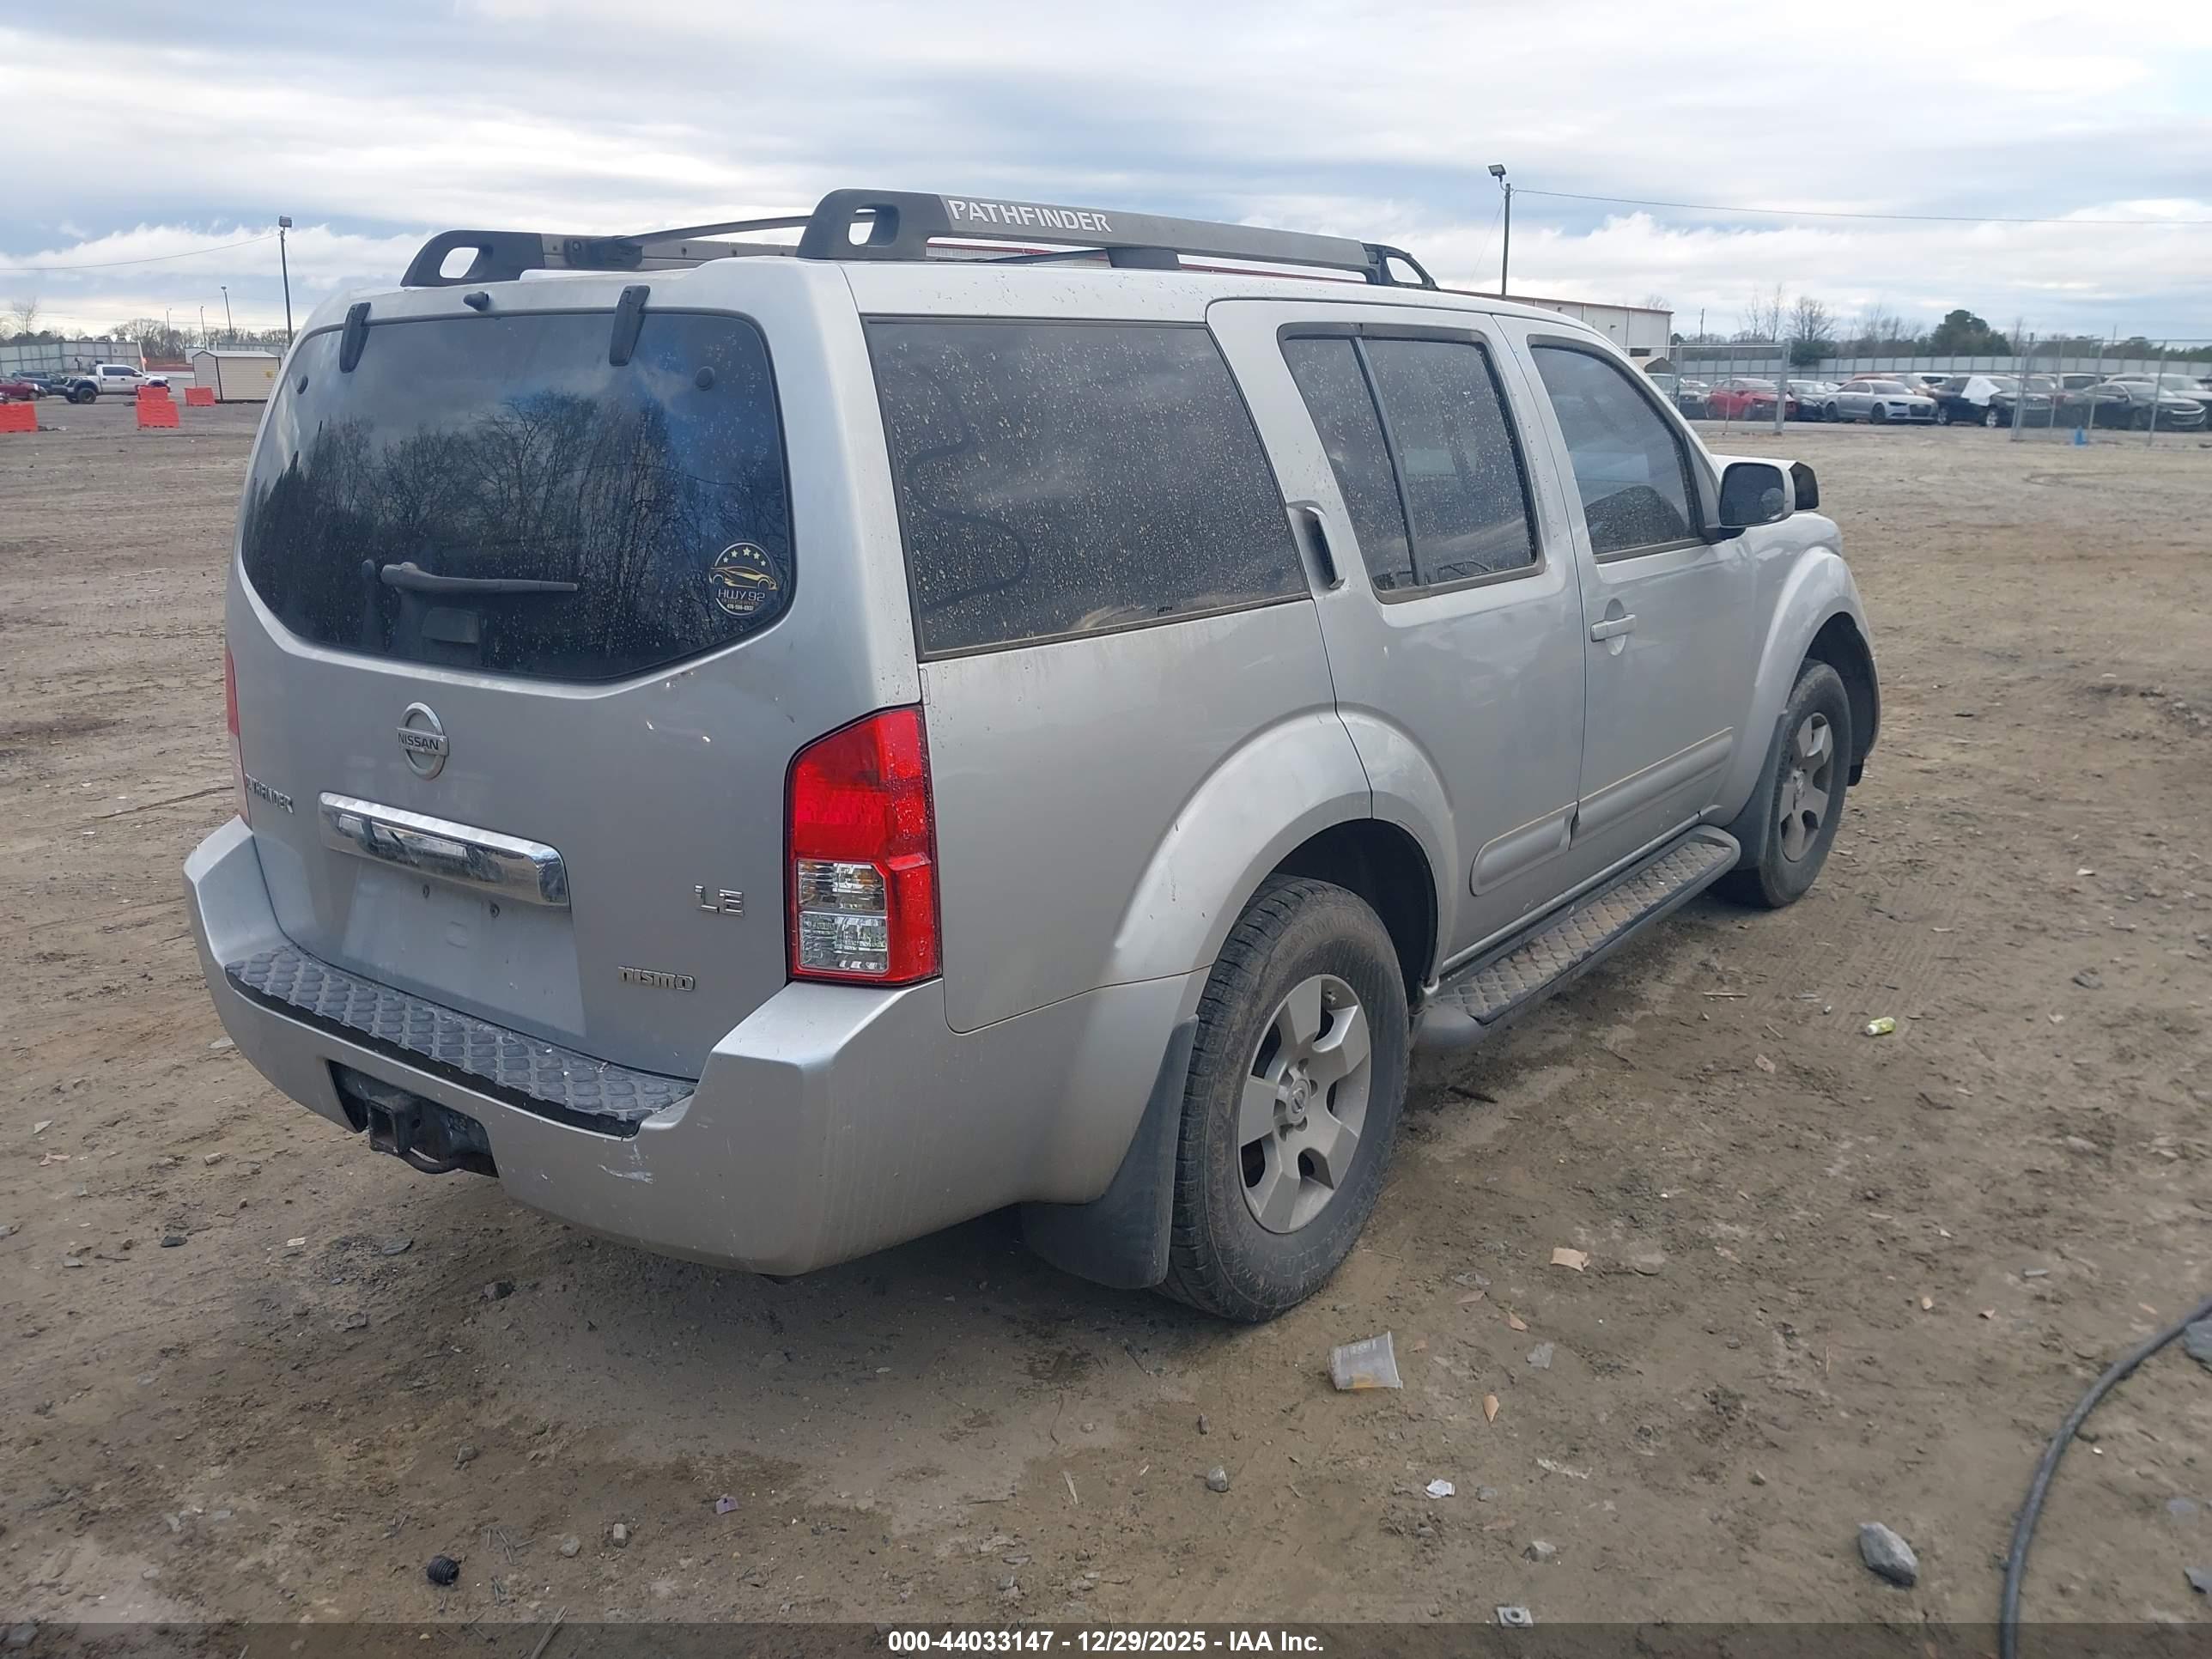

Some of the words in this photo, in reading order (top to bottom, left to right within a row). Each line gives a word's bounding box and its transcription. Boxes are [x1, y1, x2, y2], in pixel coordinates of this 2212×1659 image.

[947, 199, 1113, 233] PATHFINDER
[718, 588, 747, 600] HWY
[748, 591, 765, 602] 92
[398, 732, 439, 750] NISSAN
[695, 884, 744, 916] LE
